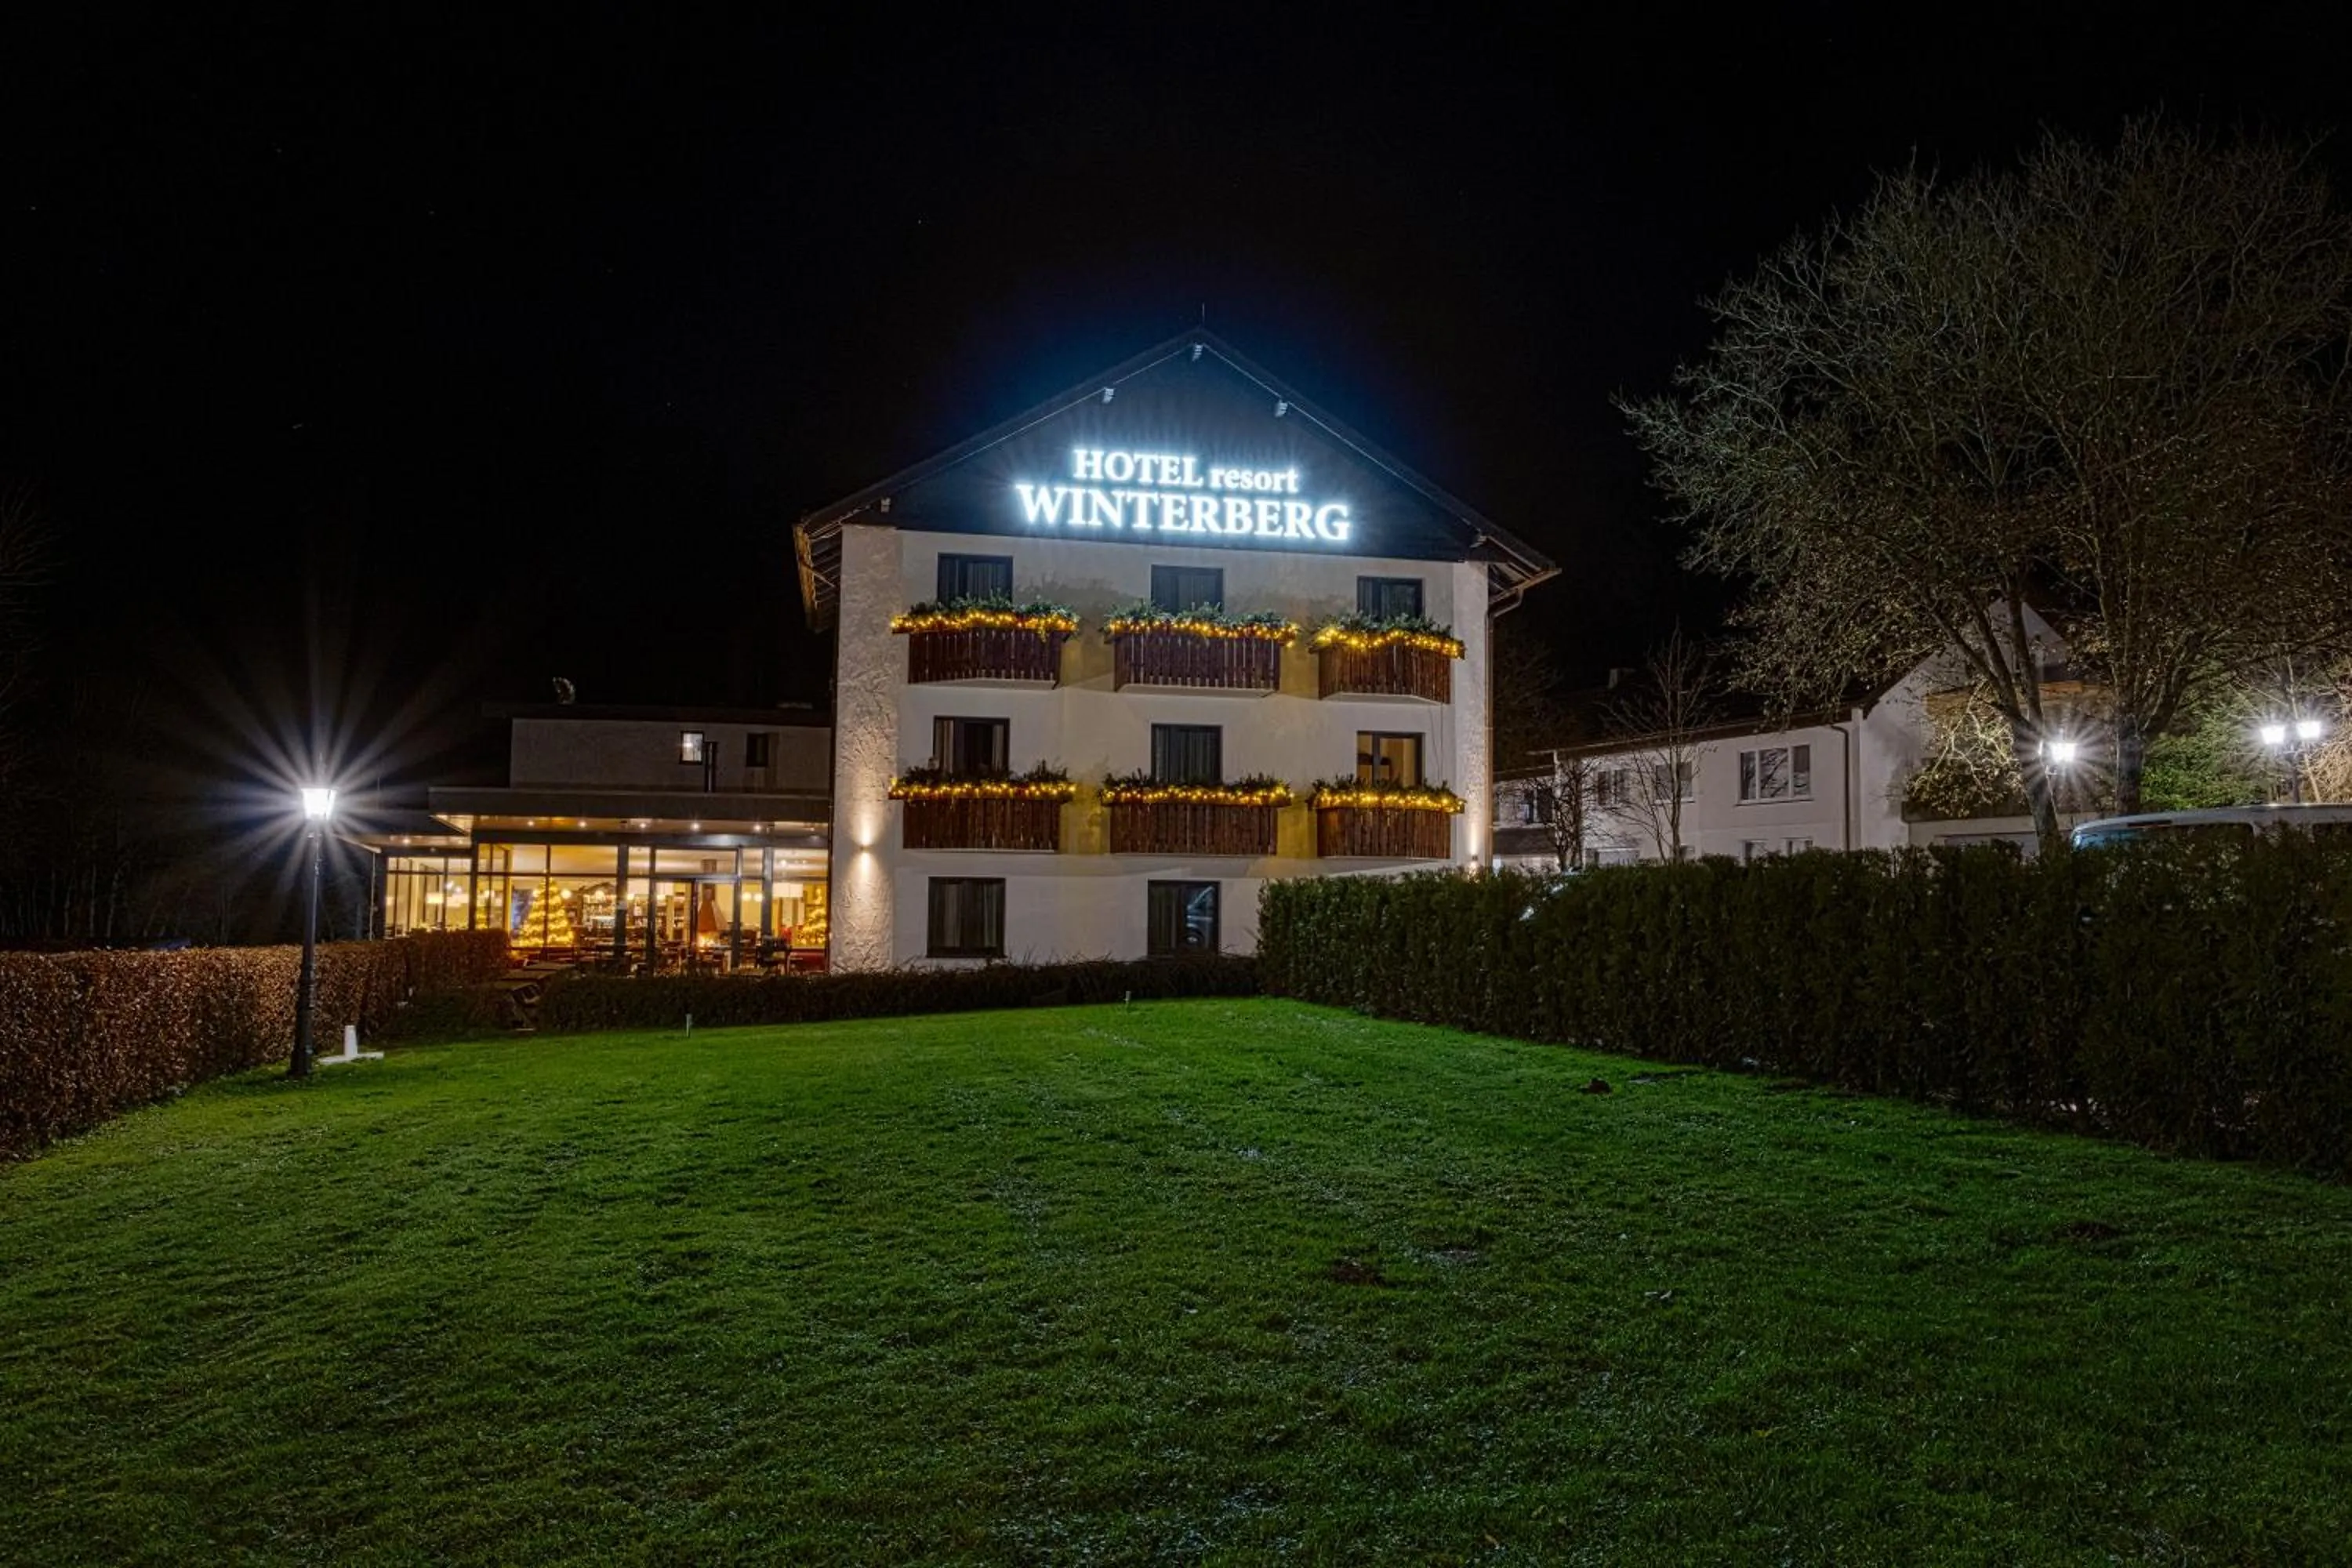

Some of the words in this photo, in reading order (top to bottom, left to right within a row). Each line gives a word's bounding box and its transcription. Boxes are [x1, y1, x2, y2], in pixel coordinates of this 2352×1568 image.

[1073, 449, 1203, 488] HOTEL
[1210, 466, 1299, 494] resort
[1015, 483, 1352, 541] WINTERBERG
